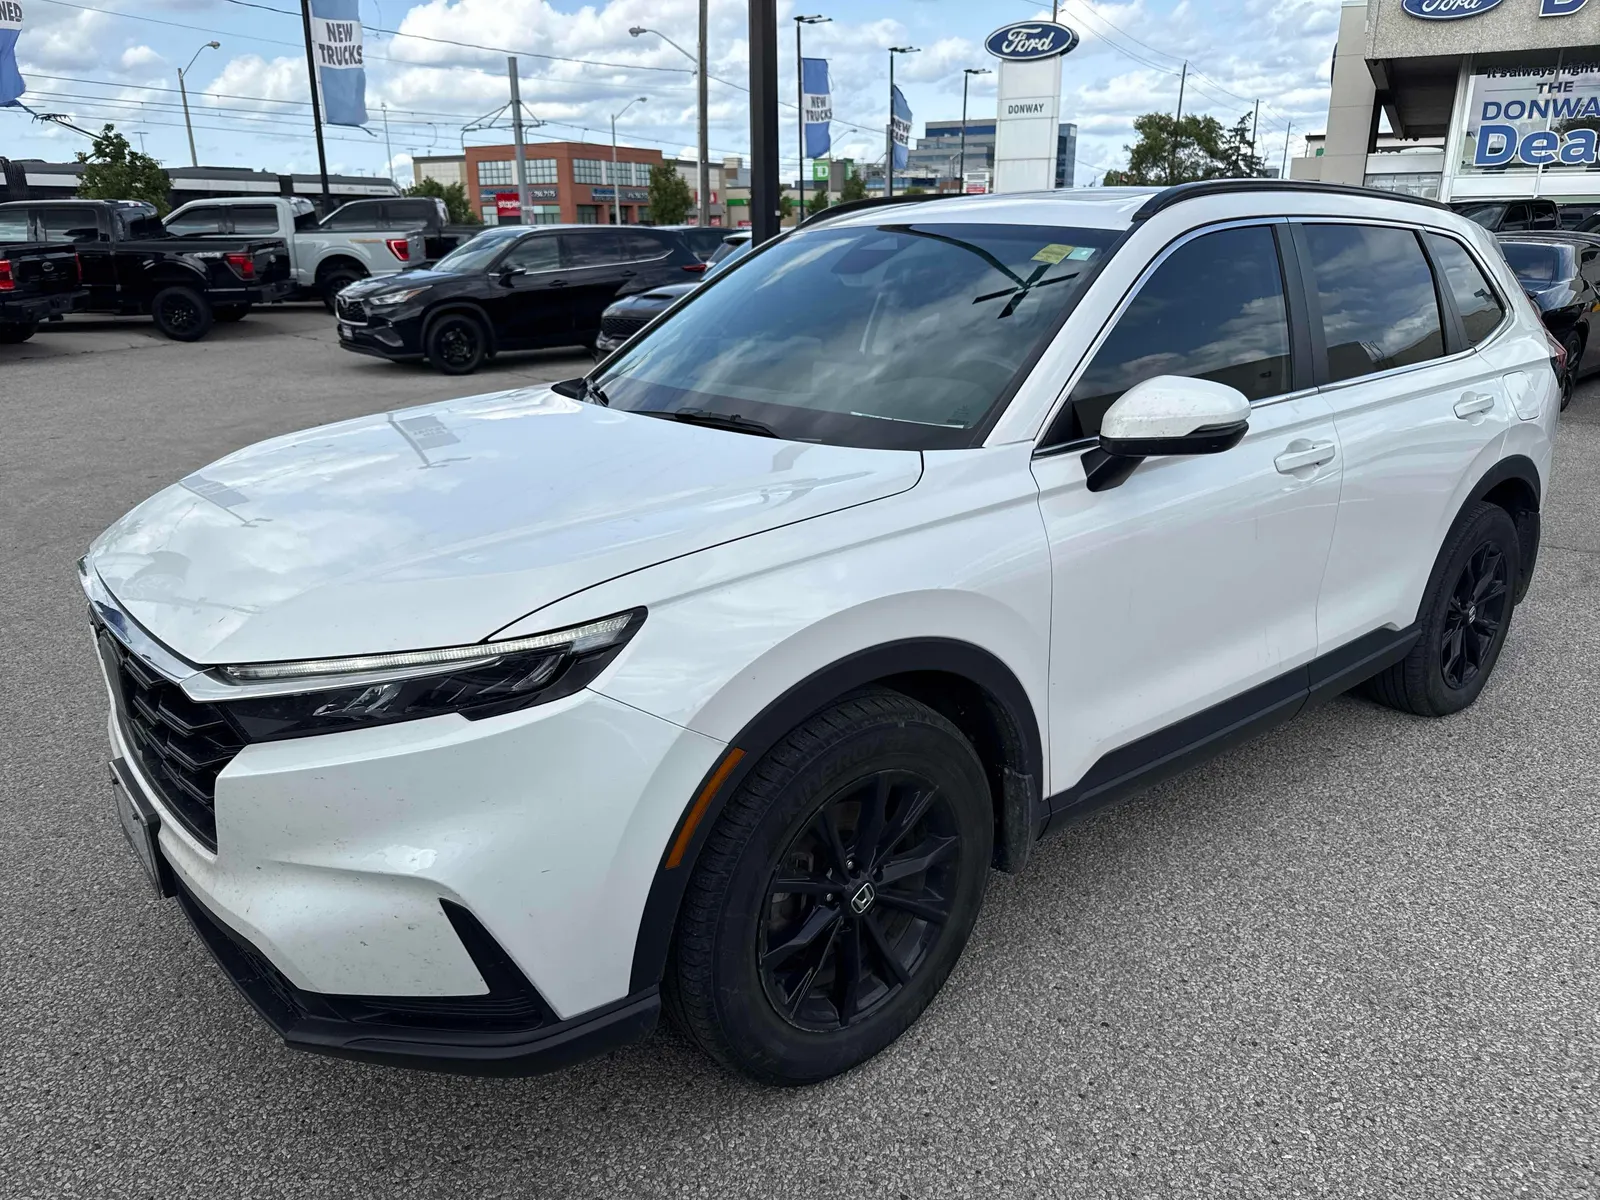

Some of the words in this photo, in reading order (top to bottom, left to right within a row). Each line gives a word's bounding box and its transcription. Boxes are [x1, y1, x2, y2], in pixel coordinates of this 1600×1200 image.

[325, 22, 353, 43] NEW
[1002, 27, 1055, 53] Ford
[318, 43, 363, 66] TRUCKS
[1508, 64, 1555, 78] always
[1561, 60, 1597, 77] right
[1536, 81, 1574, 94] THE
[810, 96, 827, 109] NEW
[1008, 103, 1044, 115] DONWAY
[1481, 97, 1600, 121] DONWA
[806, 108, 832, 122] TRUCKS
[1473, 123, 1599, 166] Dea
[498, 200, 521, 210] staple
